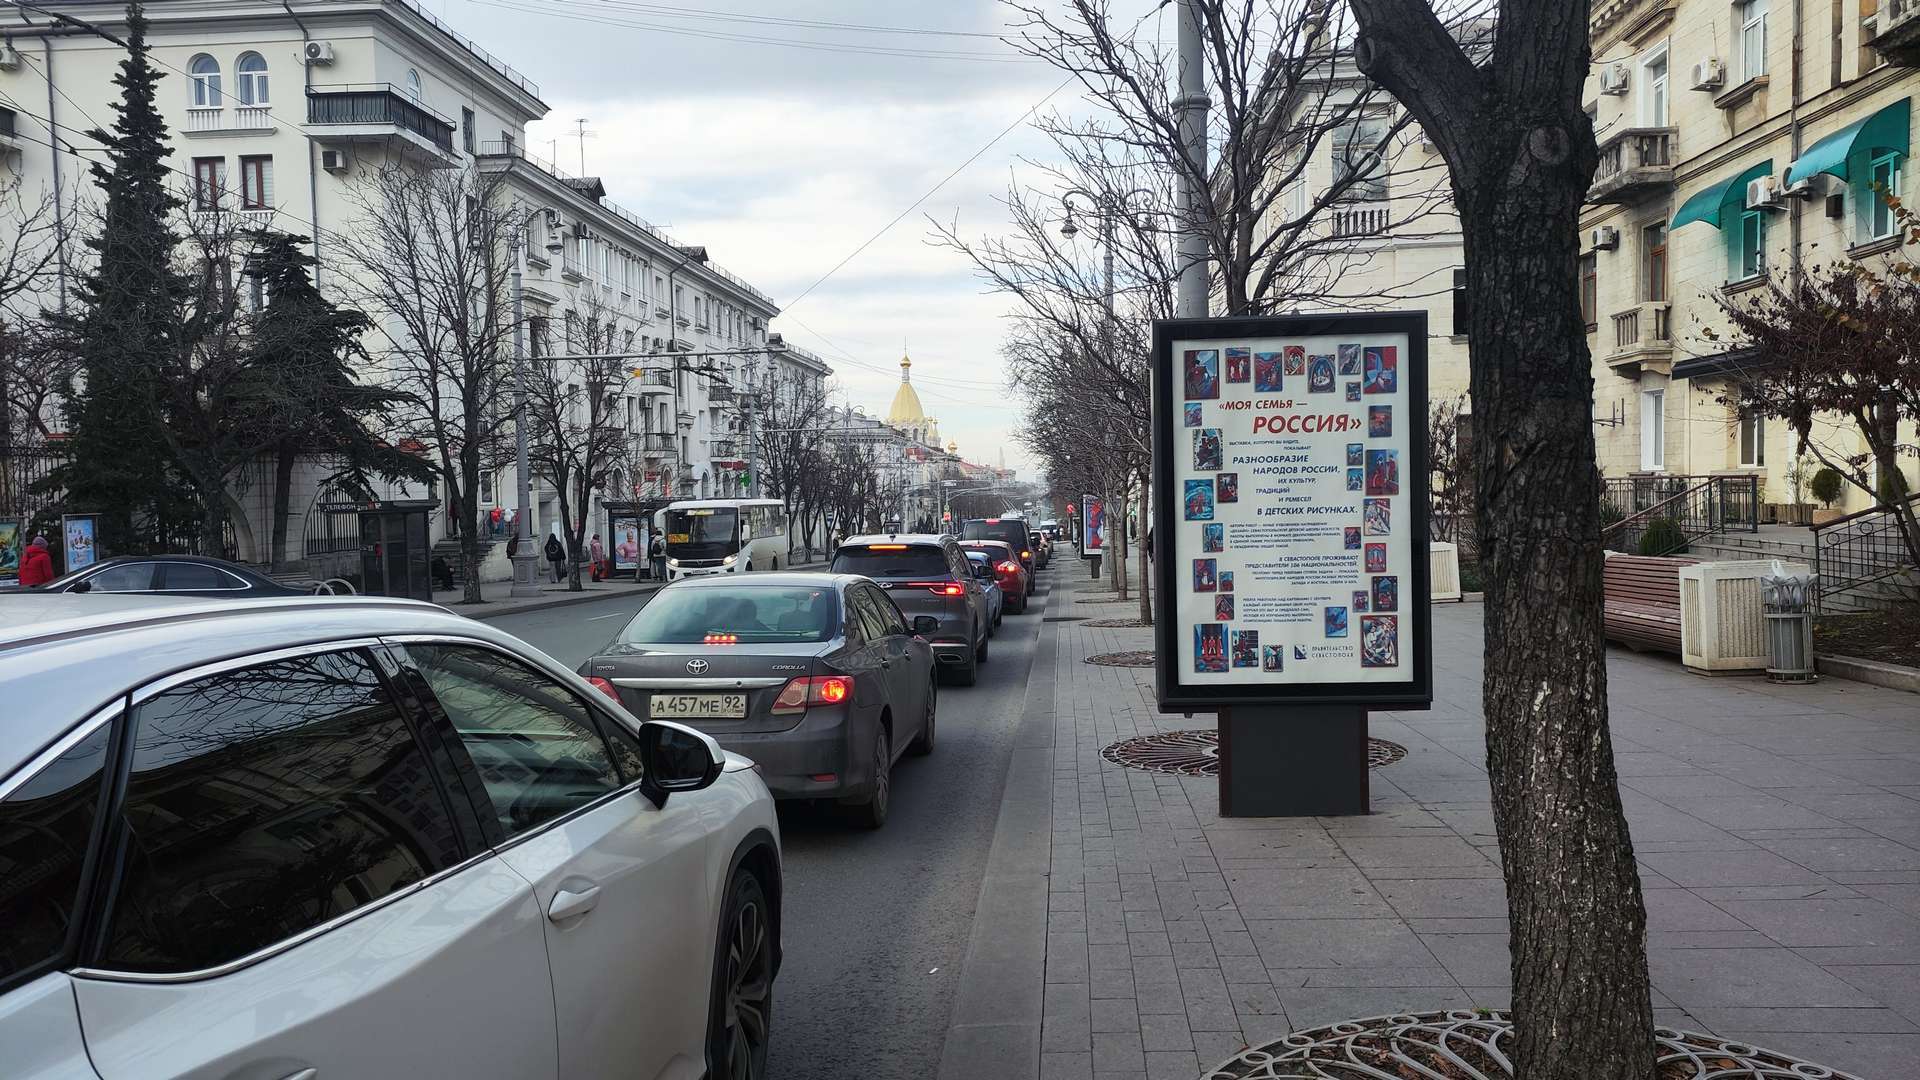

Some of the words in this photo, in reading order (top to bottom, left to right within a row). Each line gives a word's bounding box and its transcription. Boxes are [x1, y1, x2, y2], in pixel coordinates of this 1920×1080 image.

[1219, 401, 1251, 410] «МОЯ
[1256, 400, 1293, 409] СЕМЬЯ
[1253, 414, 1362, 433] РОССИЯ»
[1232, 455, 1309, 464] РАЗНООБРАЗИЕ
[1253, 466, 1298, 475] НАРОДОВ
[1301, 466, 1340, 474] РОССИИ,
[1265, 508, 1304, 516] ДЕТСКИХ
[1307, 506, 1357, 515] РИСУНКАХ.
[724, 696, 740, 709] 92
